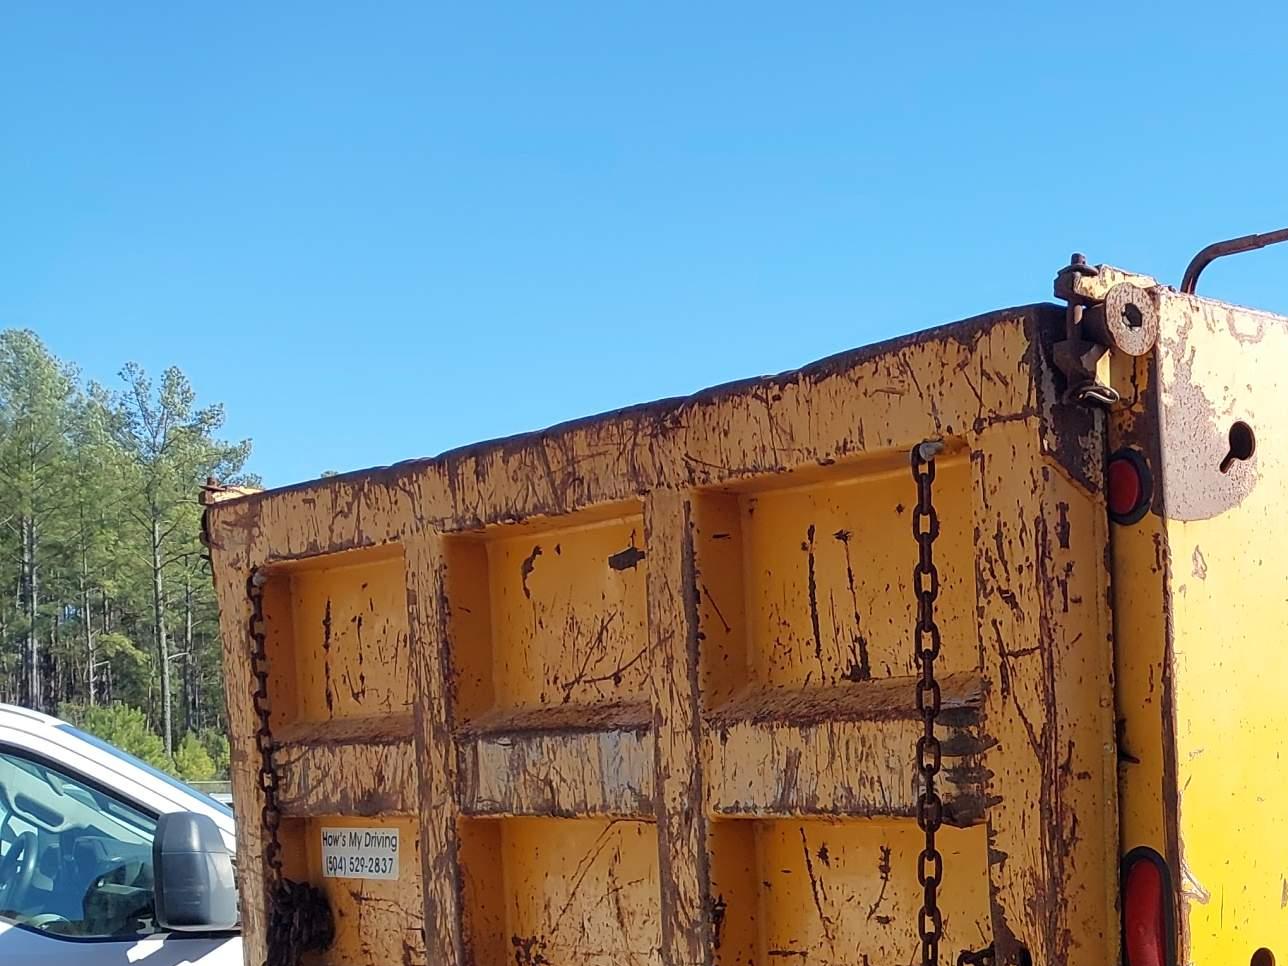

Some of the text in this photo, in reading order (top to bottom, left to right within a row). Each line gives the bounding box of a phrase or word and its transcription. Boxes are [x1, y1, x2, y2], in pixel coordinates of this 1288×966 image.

[322, 831, 398, 852] How's My Driving
[325, 855, 394, 876] (504) 529-2837
